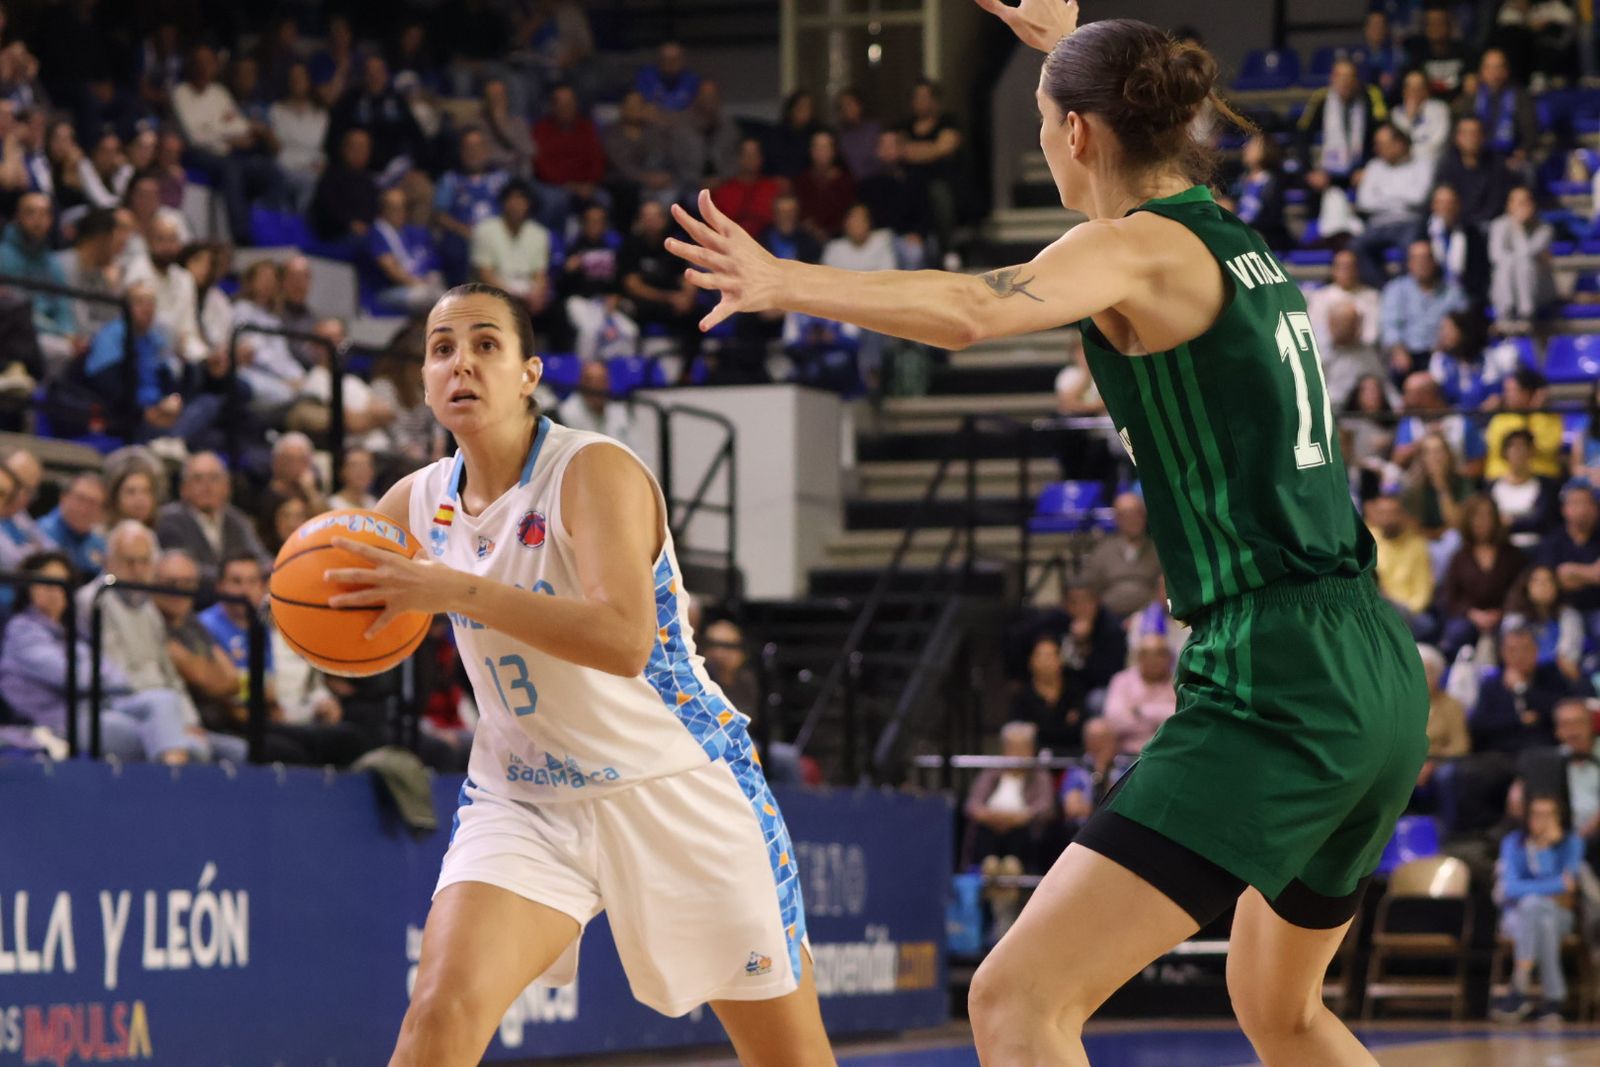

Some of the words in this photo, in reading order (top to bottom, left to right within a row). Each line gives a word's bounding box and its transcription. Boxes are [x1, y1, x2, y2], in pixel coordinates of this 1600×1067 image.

[1275, 310, 1332, 470] 17
[485, 654, 538, 717] 13
[99, 889, 132, 991] Y
[142, 860, 249, 970] LEÓN
